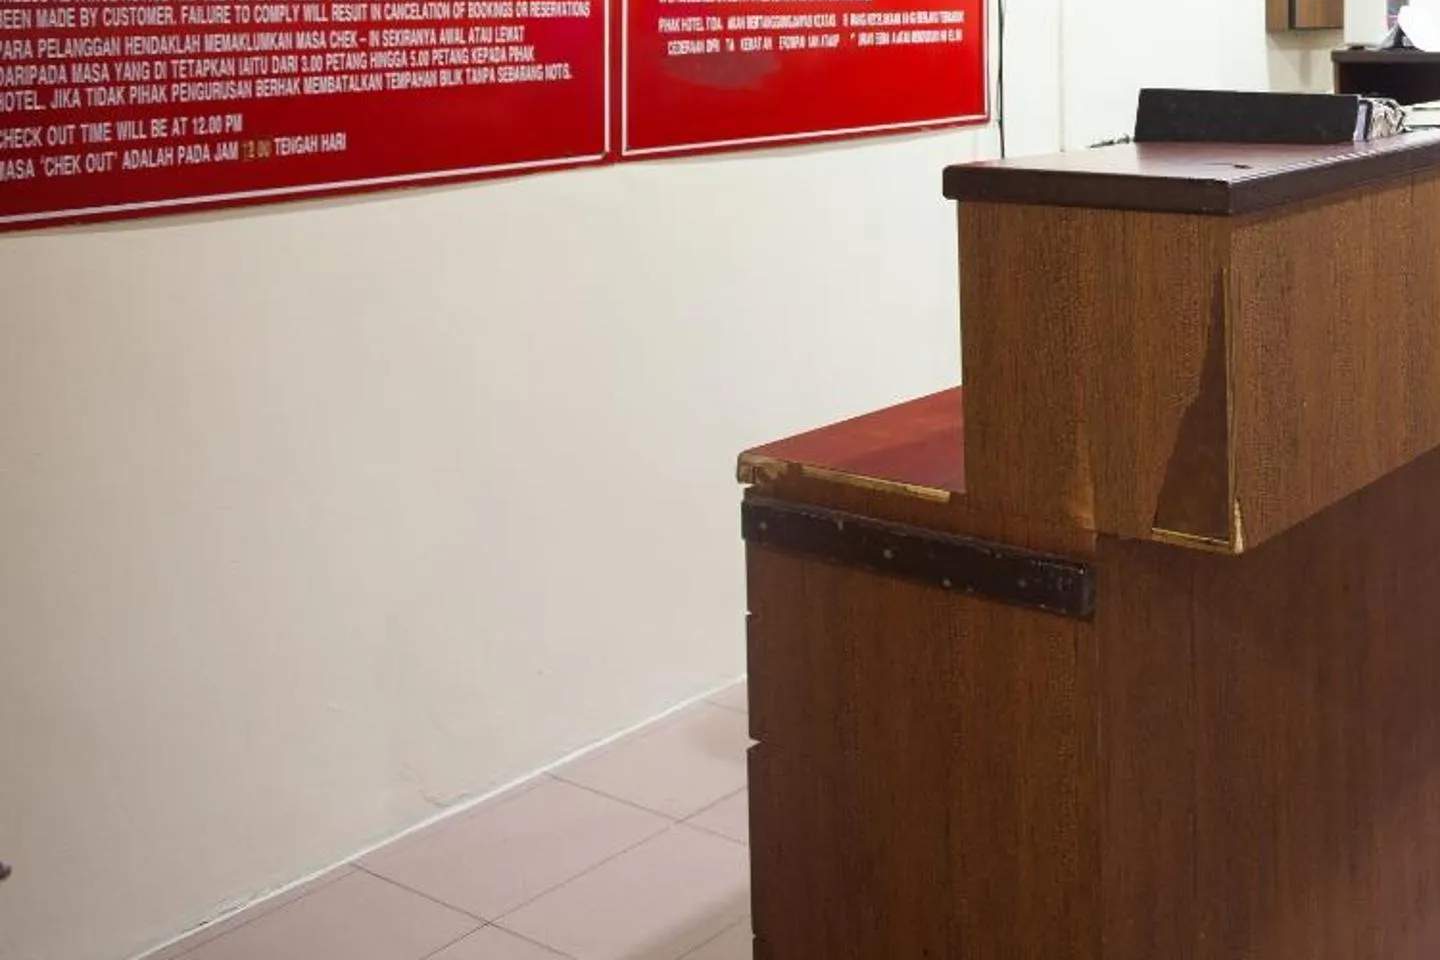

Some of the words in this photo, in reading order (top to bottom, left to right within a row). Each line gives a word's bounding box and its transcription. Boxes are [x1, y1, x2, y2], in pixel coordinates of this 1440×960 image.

[36, 9, 75, 26] MADE
[80, 8, 97, 26] BY
[102, 6, 176, 25] CUSTOMER.
[180, 6, 230, 23] FAILURE
[37, 37, 120, 57] PELANGGAN
[124, 35, 200, 54] HENDAKLAH
[71, 63, 109, 82] MASA
[114, 62, 150, 80] YANG
[153, 61, 167, 78] DI
[171, 58, 235, 77] TETAPKAN
[50, 89, 81, 107] JIKA
[86, 87, 125, 105] TIDAK
[129, 85, 167, 103] PIHAK
[171, 80, 252, 101] PENGURUSAN
[47, 125, 75, 145] OUT
[80, 123, 111, 142] TIME
[116, 121, 146, 139] WILL
[150, 119, 167, 137] BE
[171, 117, 187, 134] AT
[192, 116, 222, 134] 12.00
[122, 147, 173, 169] ADALAH
[177, 144, 210, 163] PADA
[274, 135, 318, 155] TENGAH
[320, 133, 346, 150] HARI
